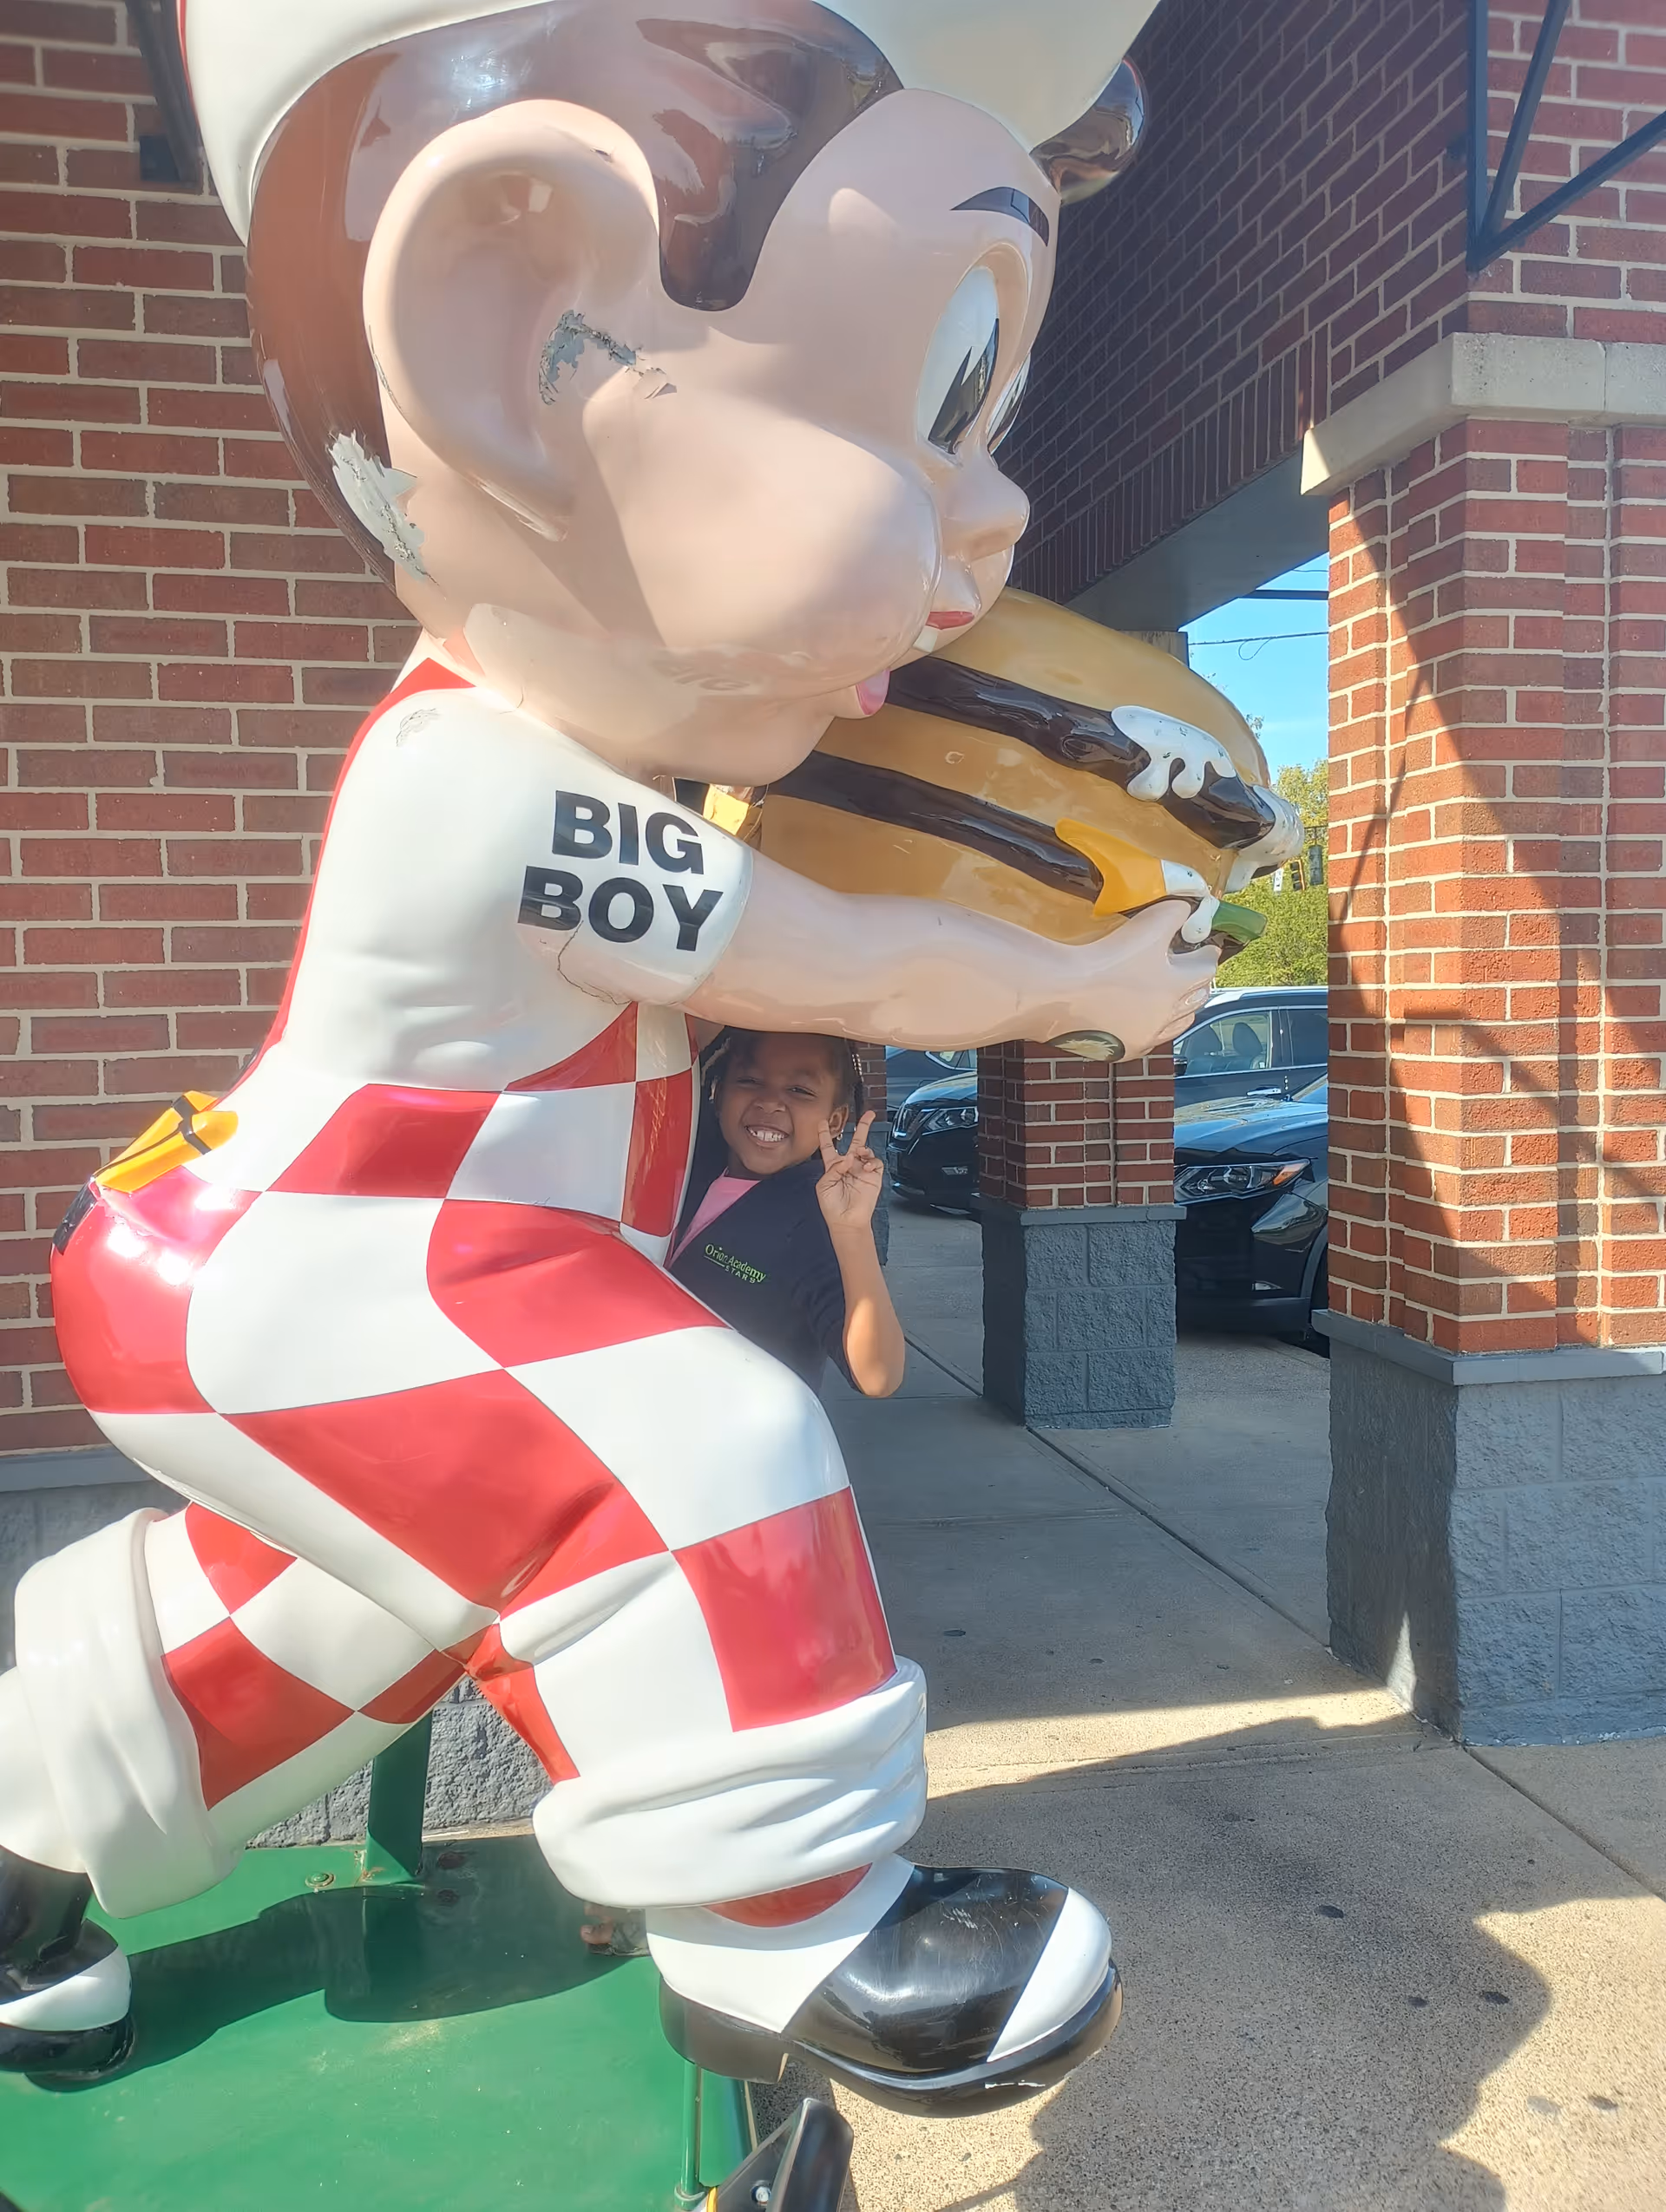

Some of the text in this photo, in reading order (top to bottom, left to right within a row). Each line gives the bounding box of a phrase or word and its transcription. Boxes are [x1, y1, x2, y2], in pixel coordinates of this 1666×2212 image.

[552, 790, 704, 874] BIG
[518, 866, 724, 952] BOY
[705, 1244, 766, 1282] Orion Academy
[725, 1266, 756, 1283] STARS
